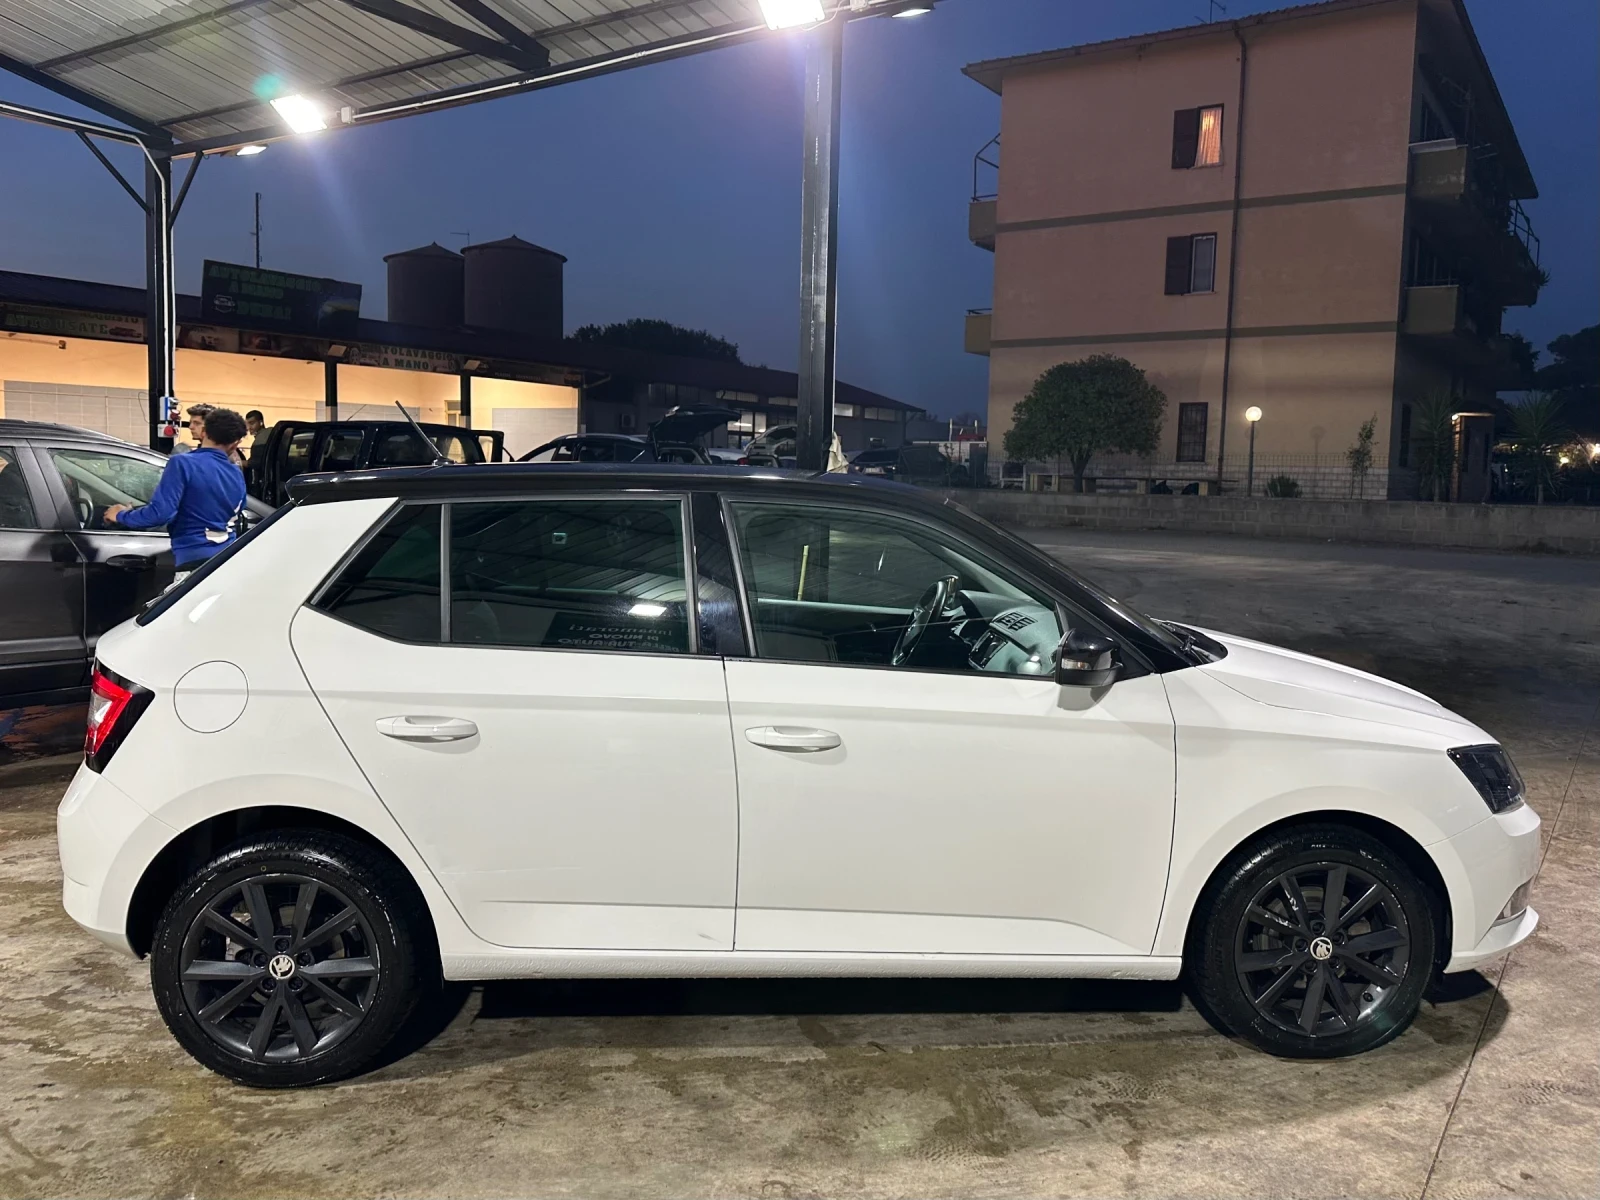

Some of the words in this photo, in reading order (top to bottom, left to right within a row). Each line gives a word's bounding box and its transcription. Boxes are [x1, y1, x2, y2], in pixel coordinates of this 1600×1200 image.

[55, 319, 109, 334] USATE
[382, 357, 390, 366] A
[394, 359, 429, 370] MANO
